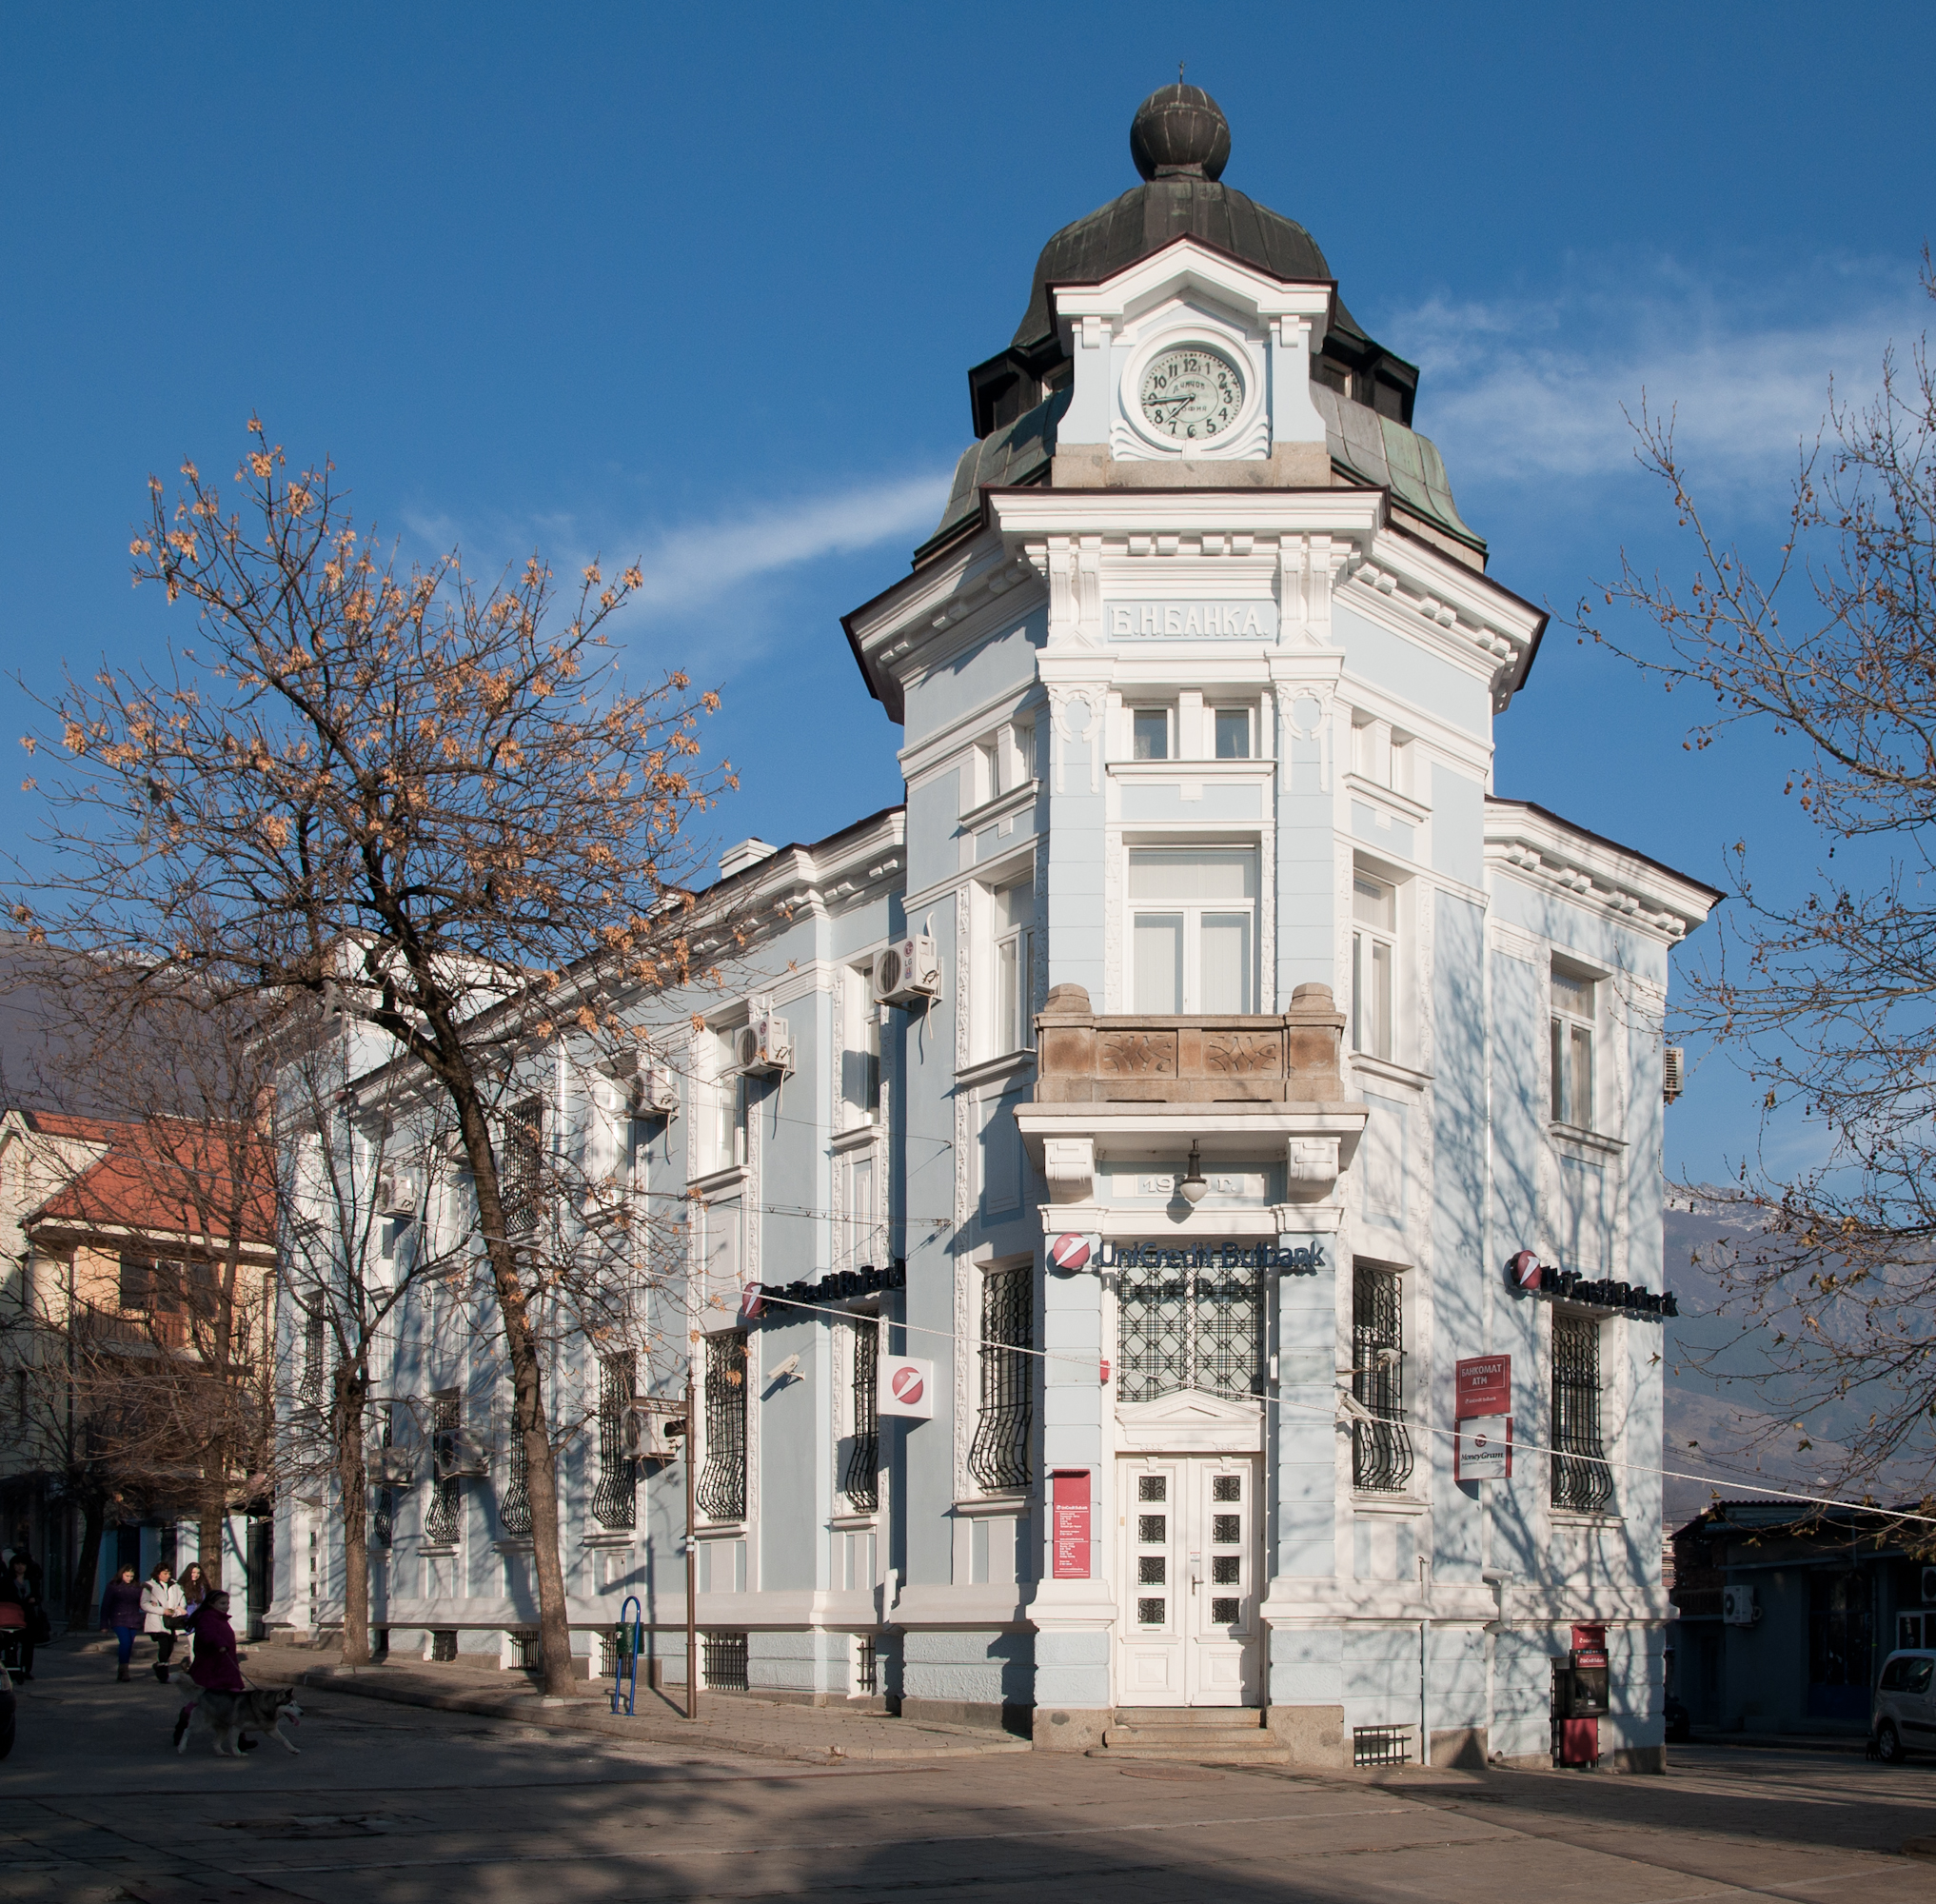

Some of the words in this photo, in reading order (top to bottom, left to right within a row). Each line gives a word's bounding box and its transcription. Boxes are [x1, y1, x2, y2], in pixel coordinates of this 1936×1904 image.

[1168, 364, 1178, 378] 11
[1183, 358, 1197, 372] 12
[1205, 362, 1211, 375] 1
[1154, 374, 1167, 389] 10
[1217, 372, 1228, 389] 2
[1223, 389, 1234, 404] 3
[1154, 409, 1164, 425] 8
[1217, 407, 1228, 422] 4
[1168, 420, 1177, 435] 7
[1187, 425, 1196, 438] 6
[1206, 418, 1216, 433] 5
[904, 958, 913, 967] LG
[1143, 1176, 1213, 1193] 19
[1099, 1240, 1214, 1268] UniCredit
[1221, 1240, 1326, 1268] Bulbank
[1461, 1363, 1502, 1378] БАНКОМАТ
[1472, 1376, 1488, 1386] ATM
[1461, 1452, 1504, 1461] MoneyGram
